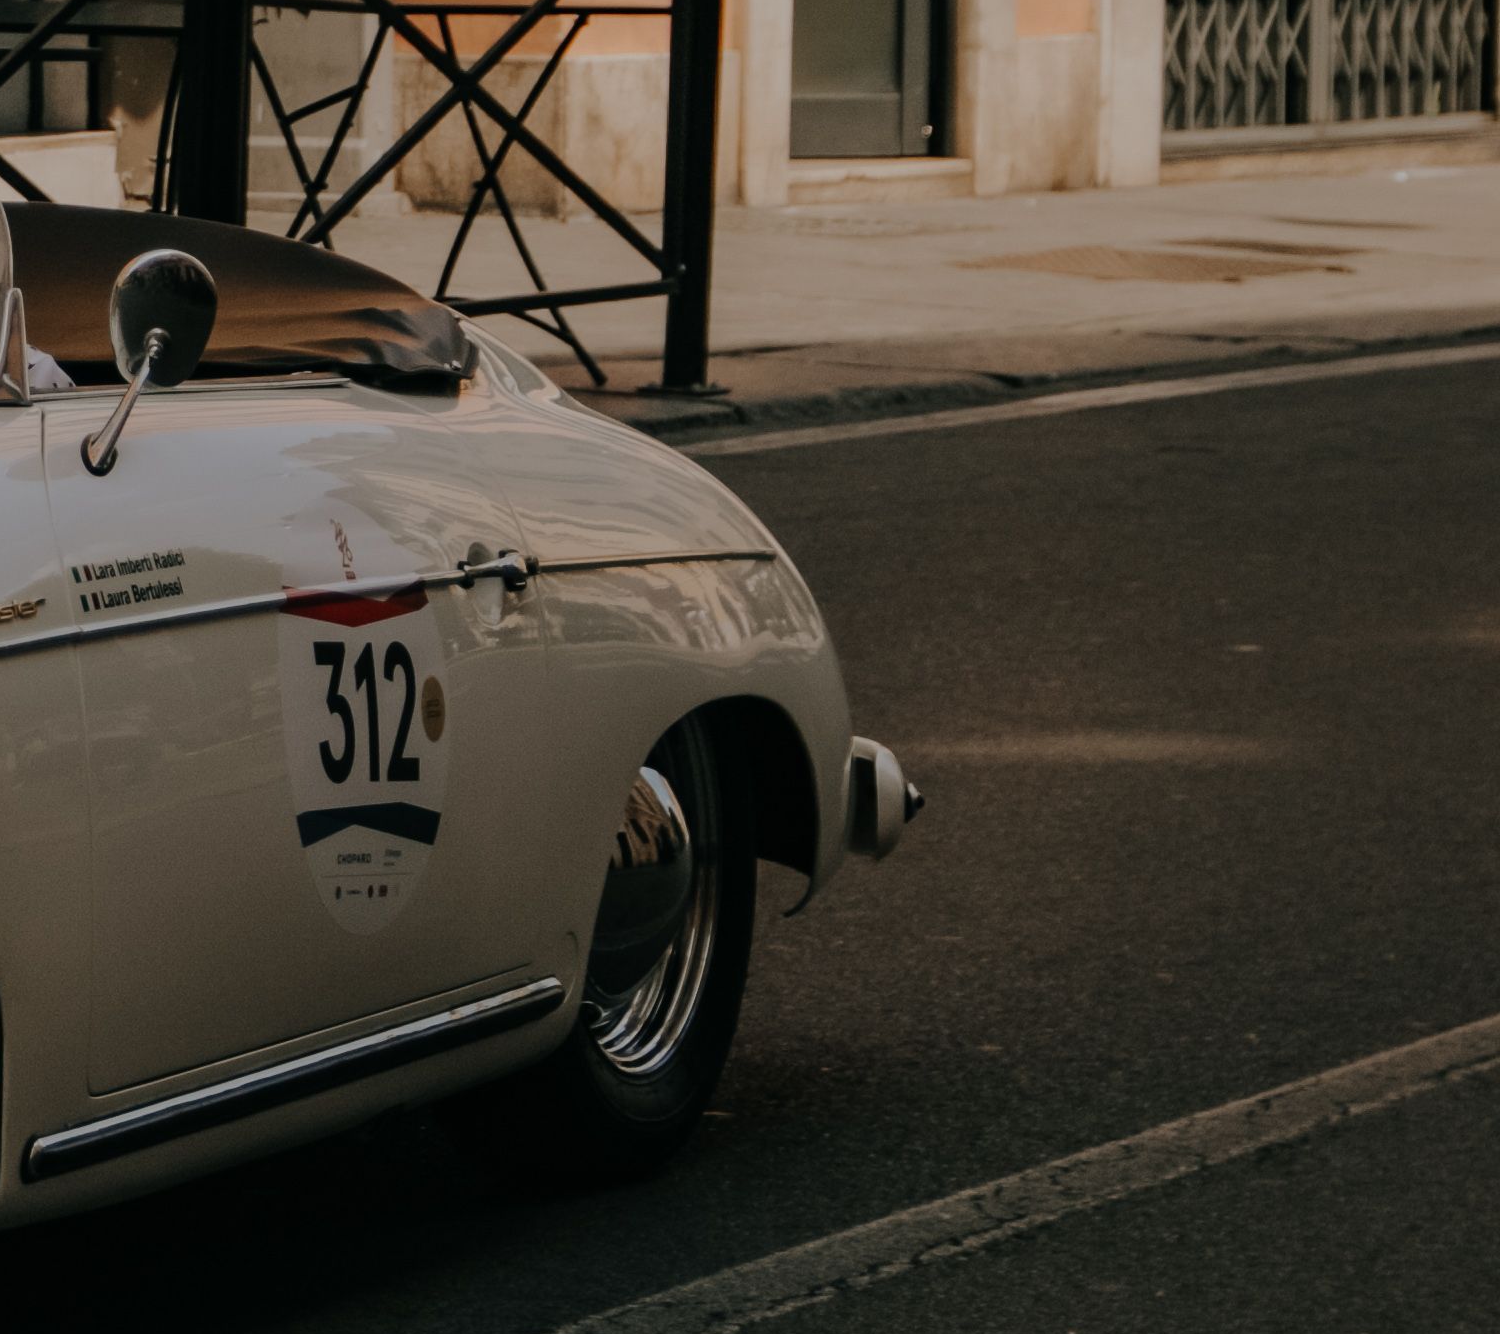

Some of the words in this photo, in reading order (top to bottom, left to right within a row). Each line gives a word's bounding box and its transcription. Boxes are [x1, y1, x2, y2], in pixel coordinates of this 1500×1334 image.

[91, 561, 117, 581] Lara
[116, 555, 154, 577] Imberti
[153, 548, 186, 571] Radici
[101, 587, 132, 609] Laura
[132, 576, 185, 604] Bertulessi
[312, 640, 421, 785] 312
